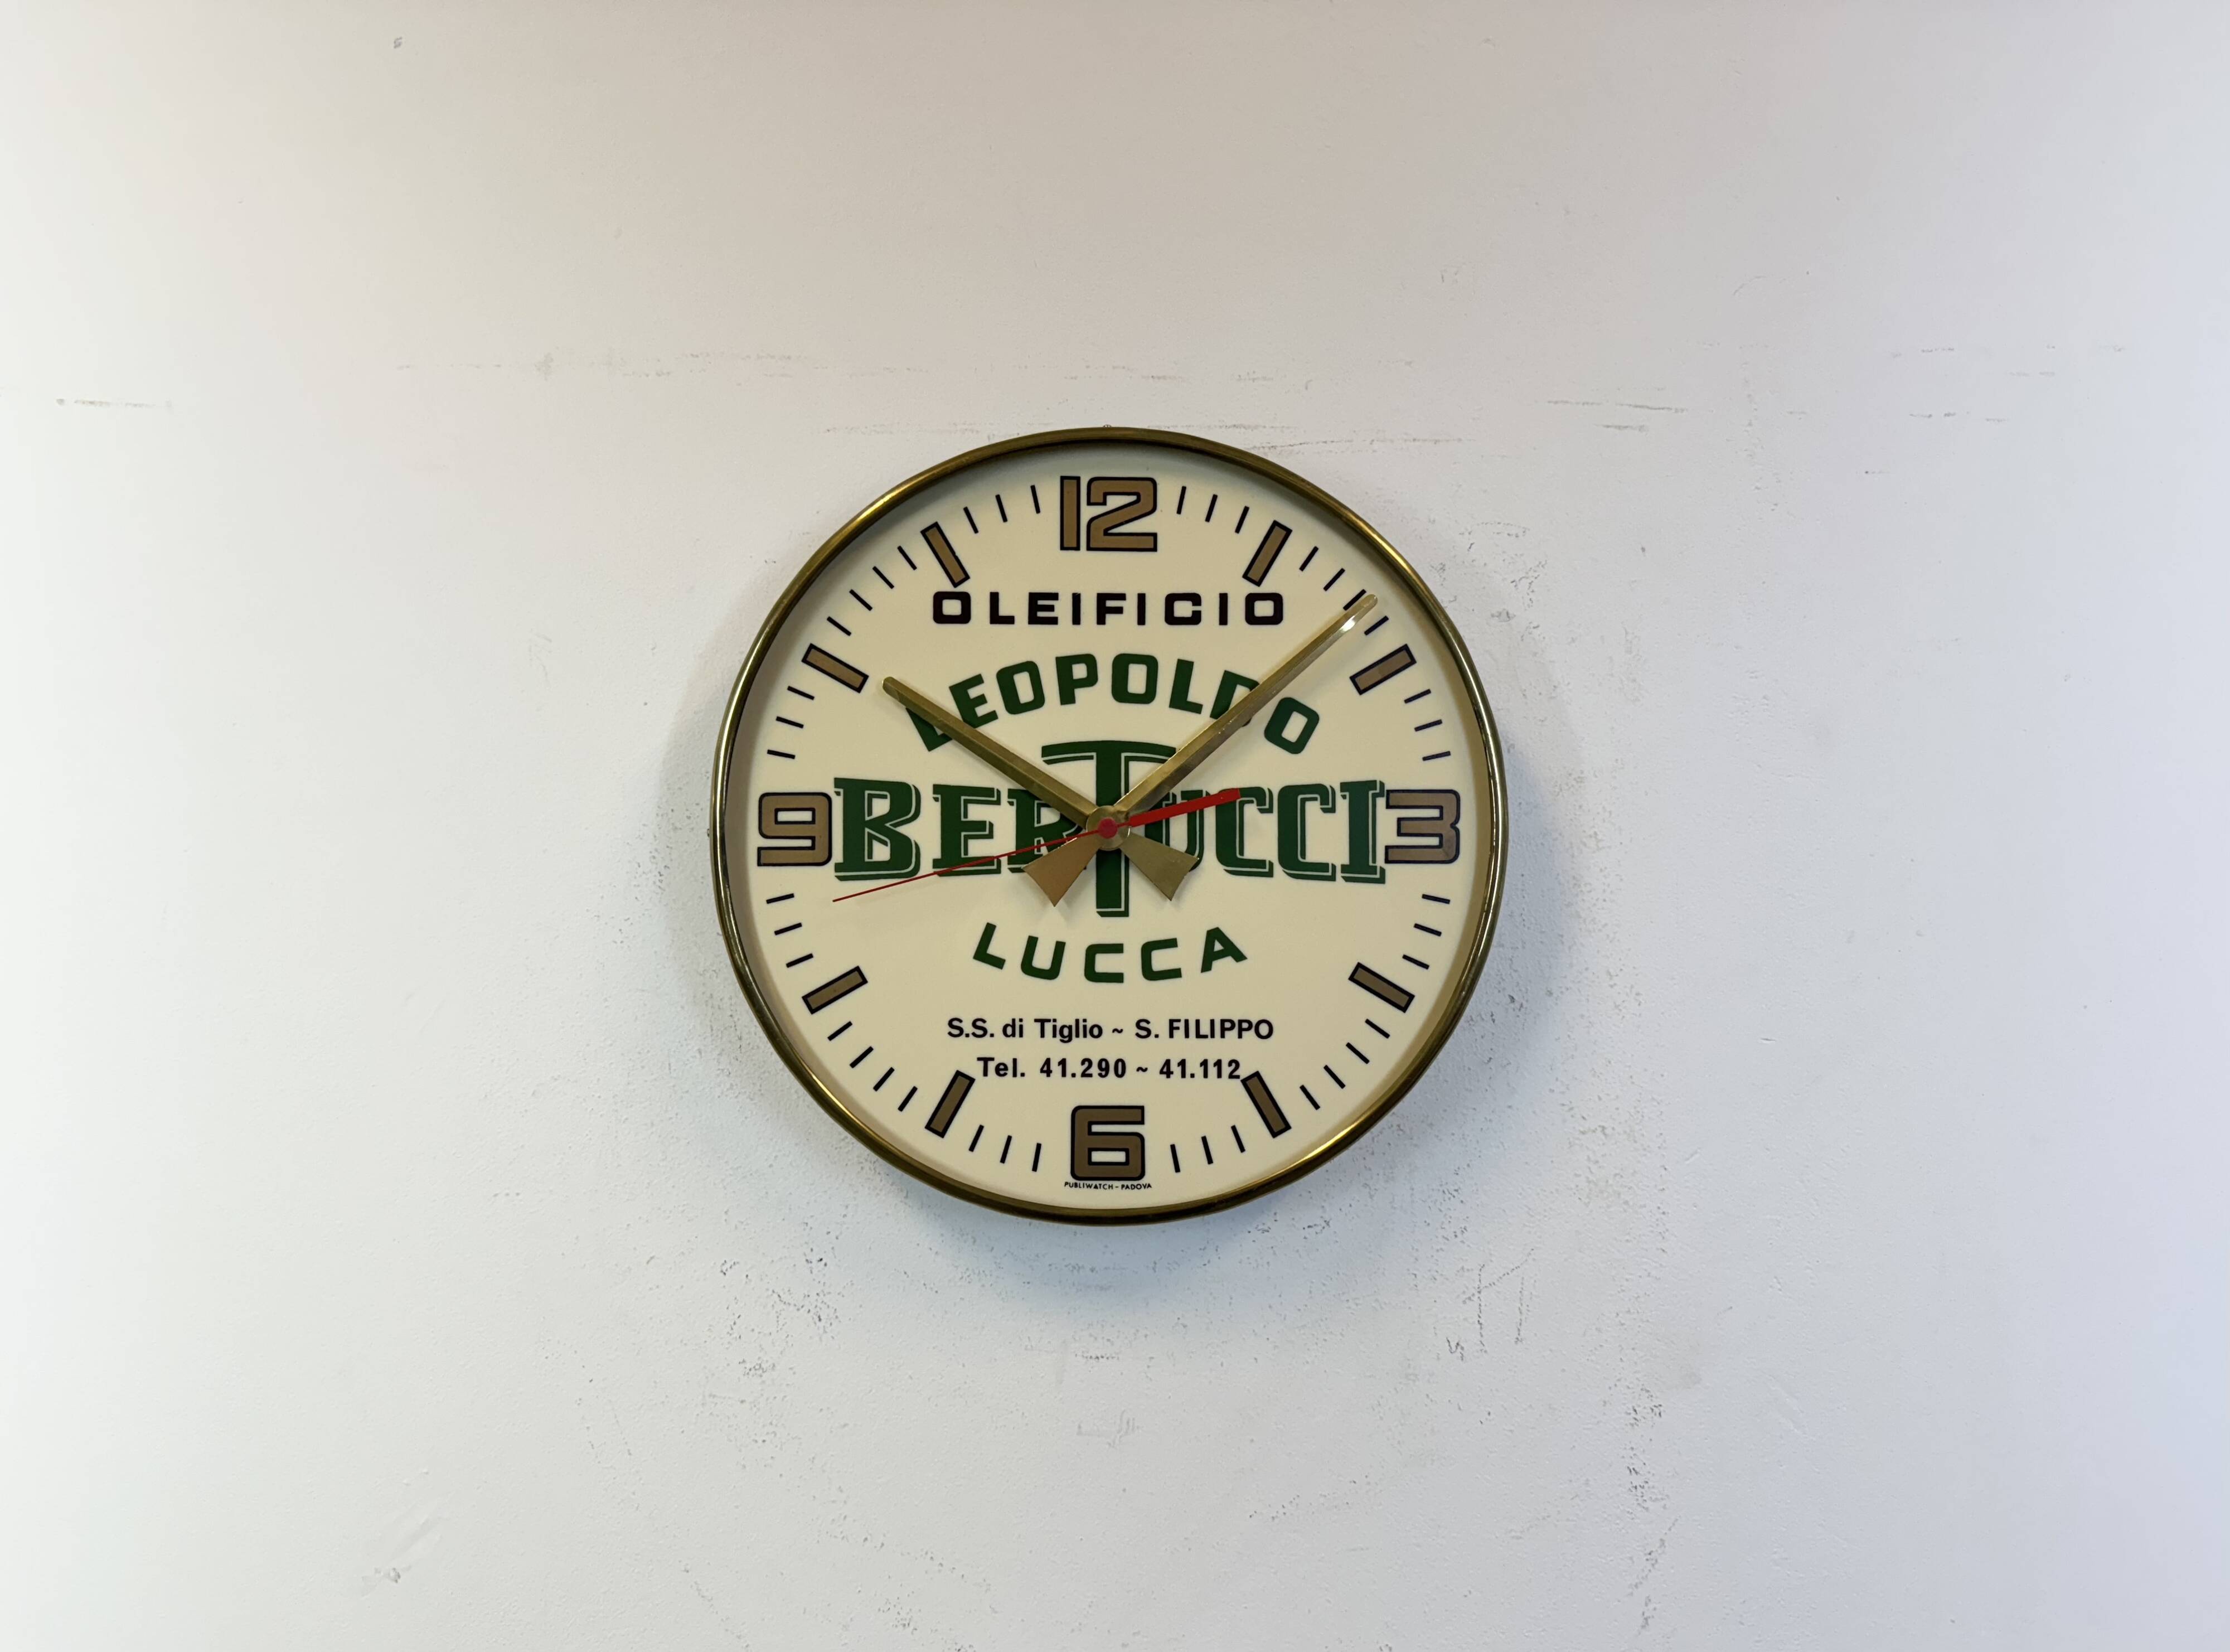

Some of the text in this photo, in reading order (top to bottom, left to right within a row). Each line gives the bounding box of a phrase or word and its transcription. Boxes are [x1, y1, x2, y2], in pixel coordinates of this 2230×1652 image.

[1059, 475, 1158, 553] 12
[932, 591, 1284, 626] OLEIFICIO
[757, 792, 833, 867] 9
[1385, 789, 1462, 865] 3
[973, 922, 1248, 984] LUCCA
[947, 1018, 995, 1039] S.S.
[1002, 1018, 1024, 1038] di
[1034, 1018, 1103, 1044] Tiglio
[1135, 1019, 1159, 1039] S.
[1169, 1019, 1274, 1040] FILIPPO
[977, 1057, 1025, 1077] Tel.
[1040, 1057, 1127, 1078] 41.290
[1159, 1058, 1240, 1079] 41.112
[1070, 1104, 1146, 1181] 6
[1064, 1181, 1113, 1190] PUBLIWATCH
